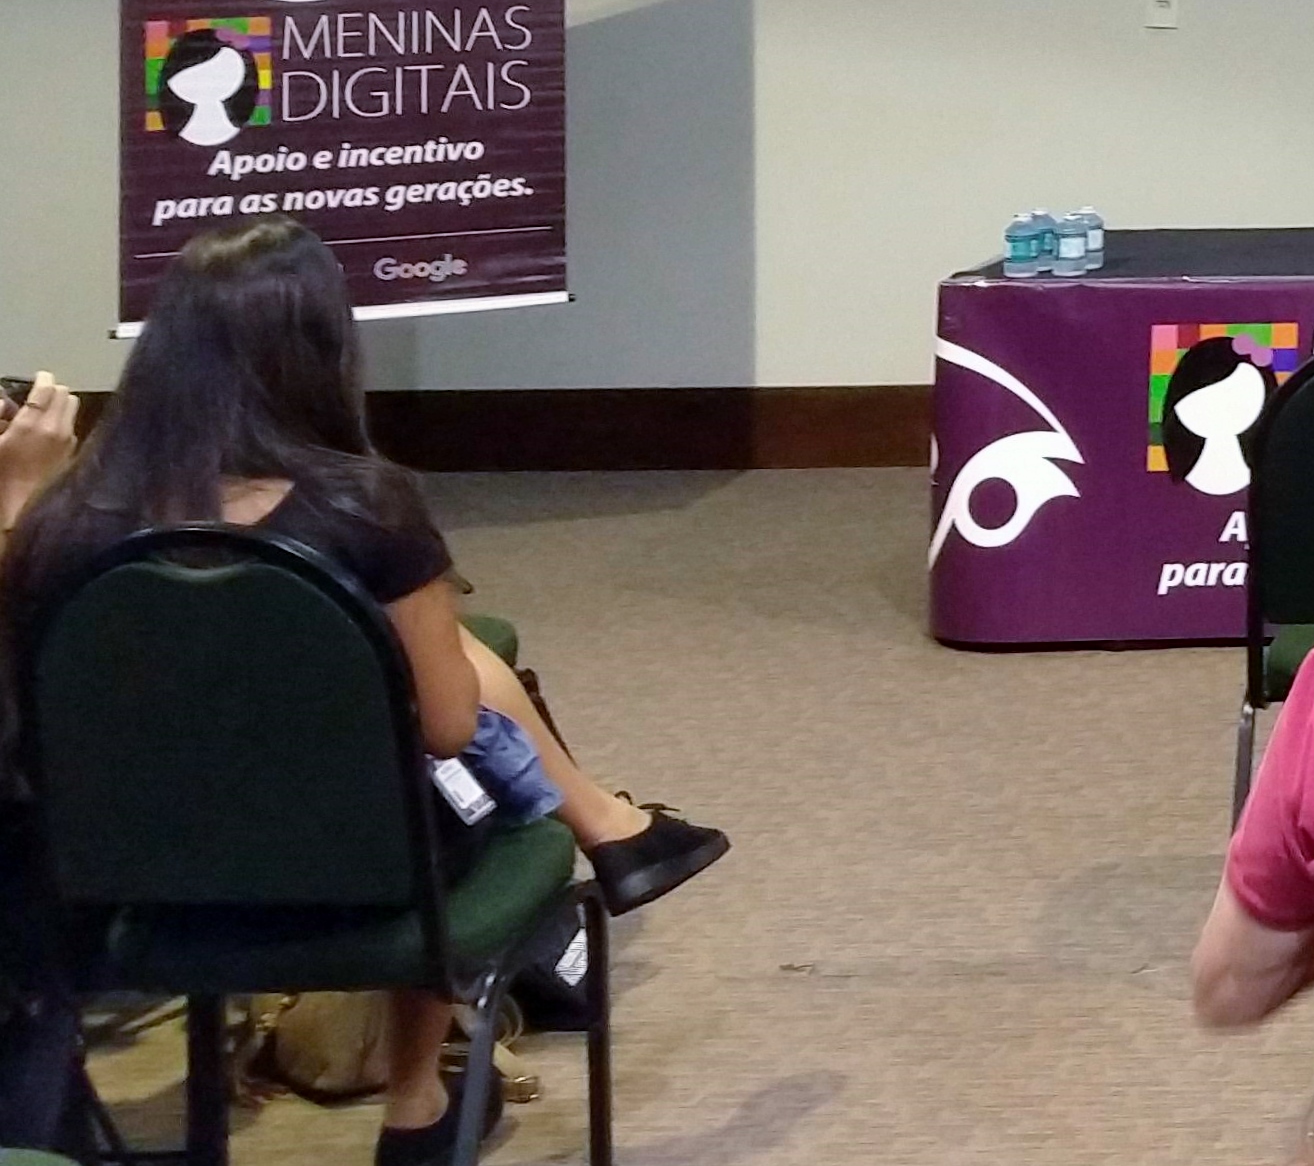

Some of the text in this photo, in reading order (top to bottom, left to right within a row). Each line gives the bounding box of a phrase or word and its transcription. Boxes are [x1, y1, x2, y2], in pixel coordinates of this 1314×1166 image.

[281, 4, 532, 60] MENINAS
[281, 60, 532, 122] DIGITAIS
[207, 137, 485, 180] Apoio e incentivo
[152, 173, 534, 225] para as novas gerações.
[374, 253, 468, 282] Google
[1157, 562, 1249, 595] para
